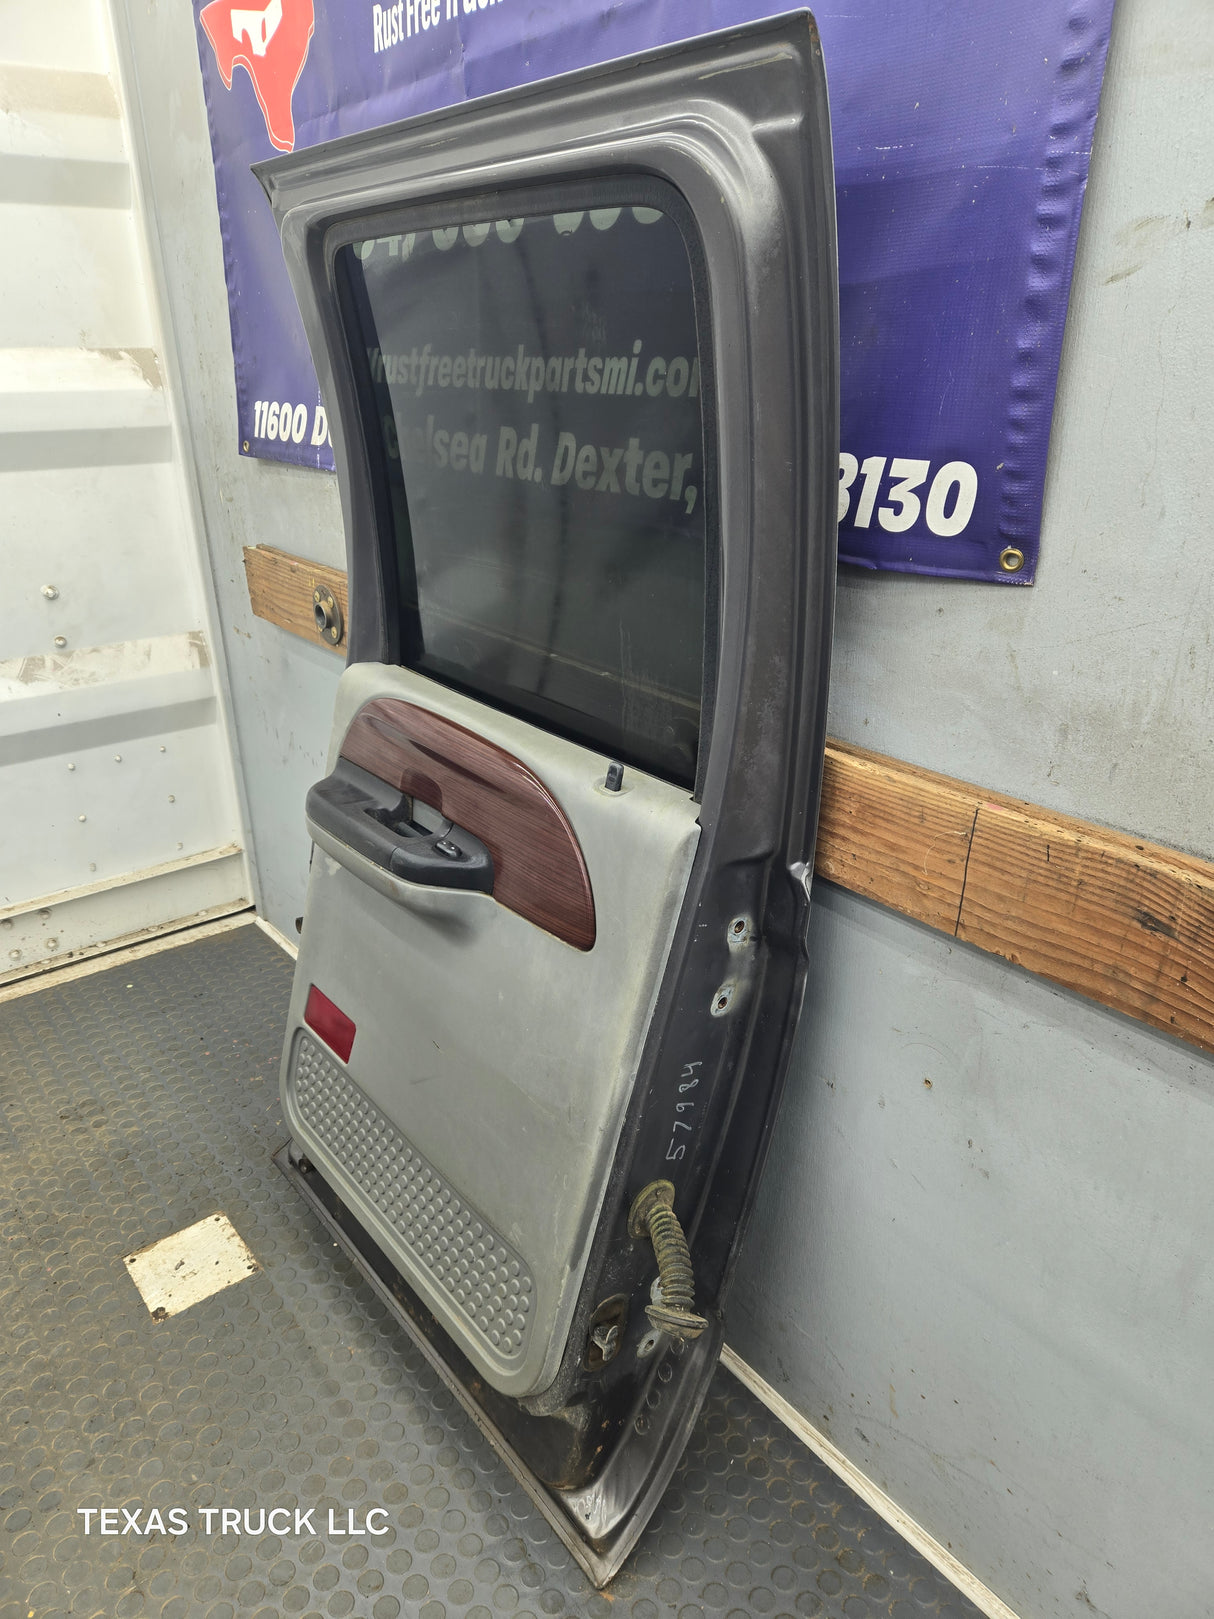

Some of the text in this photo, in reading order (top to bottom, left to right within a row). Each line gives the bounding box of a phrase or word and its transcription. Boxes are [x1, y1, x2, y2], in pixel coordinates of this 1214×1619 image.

[372, 3, 404, 53] Rust
[406, 0, 440, 38] Free
[254, 400, 308, 444] 11600
[496, 423, 543, 483] Rd.
[551, 432, 698, 514] Dexter,
